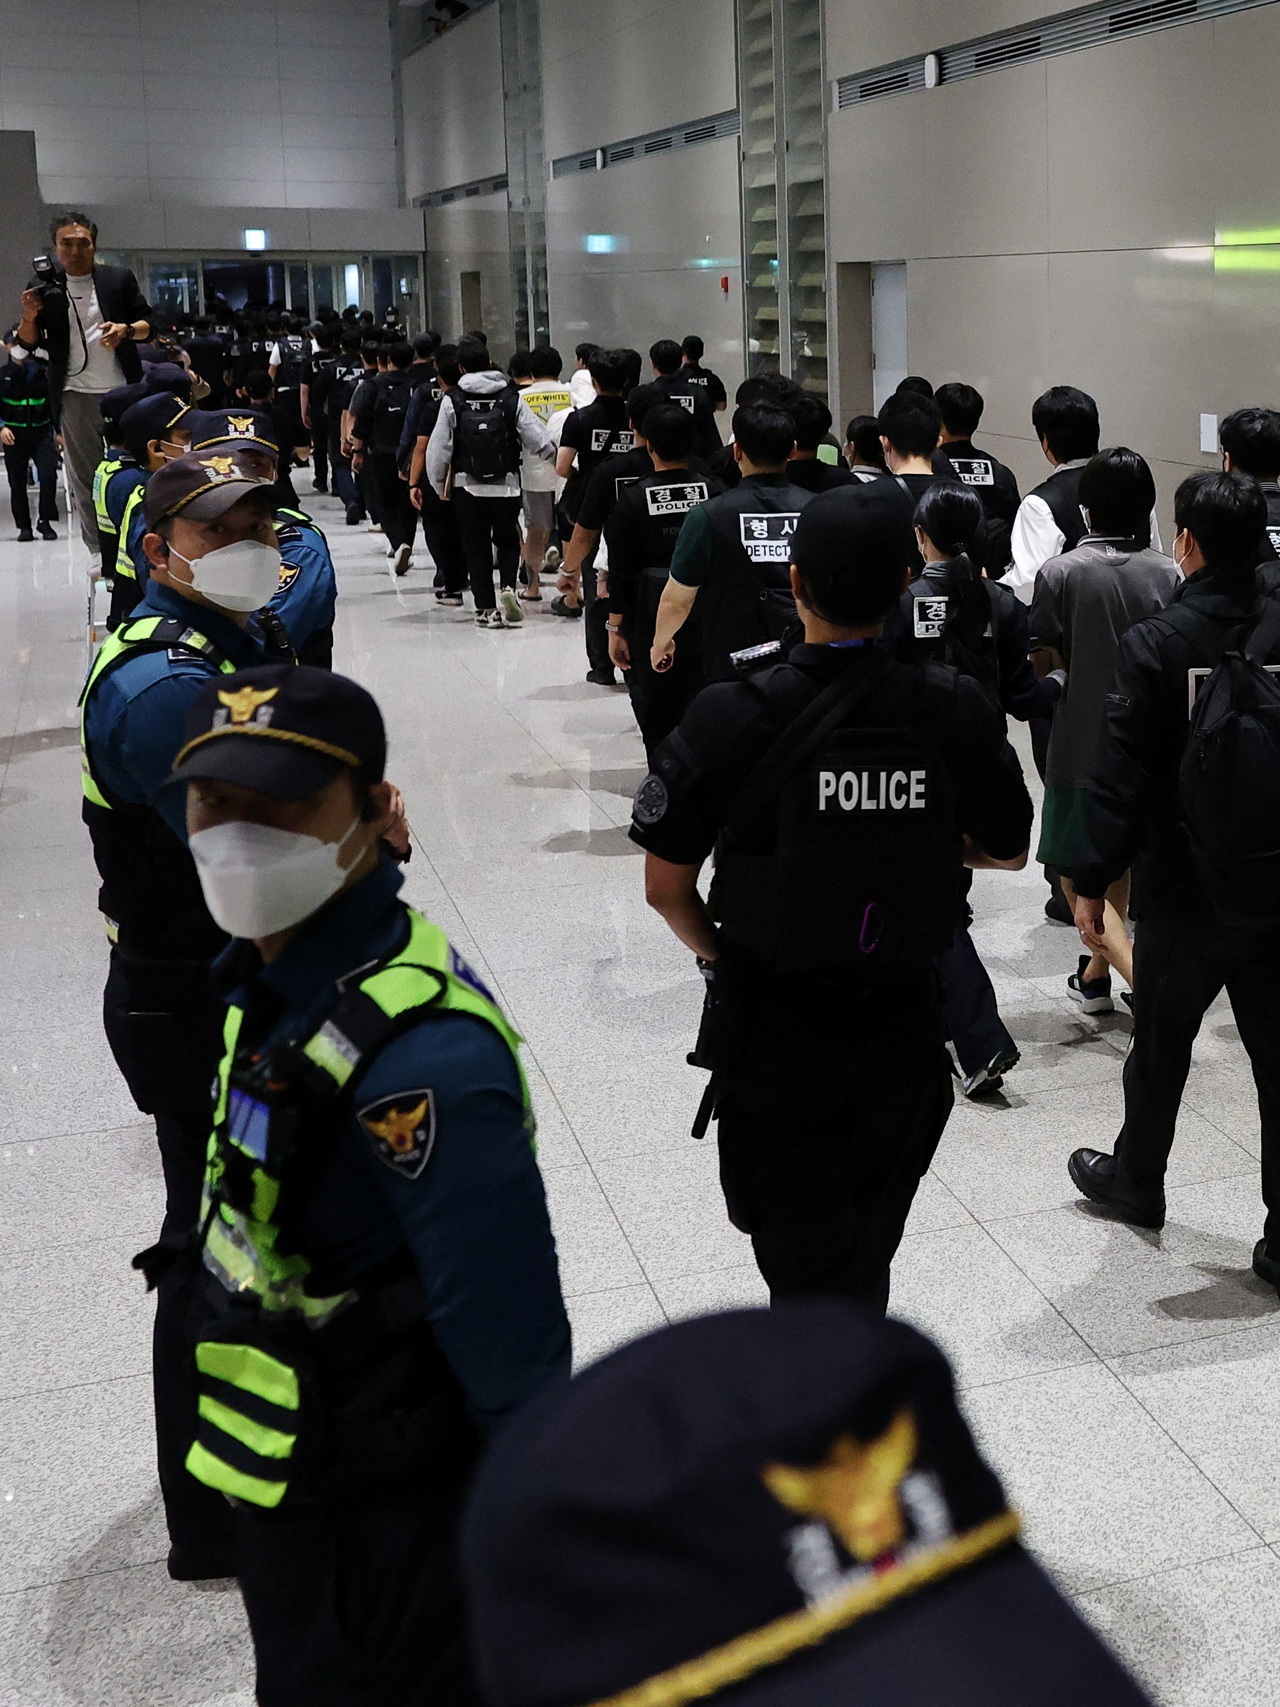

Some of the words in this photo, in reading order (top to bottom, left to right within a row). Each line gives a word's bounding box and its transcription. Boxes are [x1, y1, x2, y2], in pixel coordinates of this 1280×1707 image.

[962, 475, 988, 483] LICE
[656, 501, 699, 511] POLIC
[746, 544, 788, 557] DETECT
[818, 770, 926, 811] POLICE
